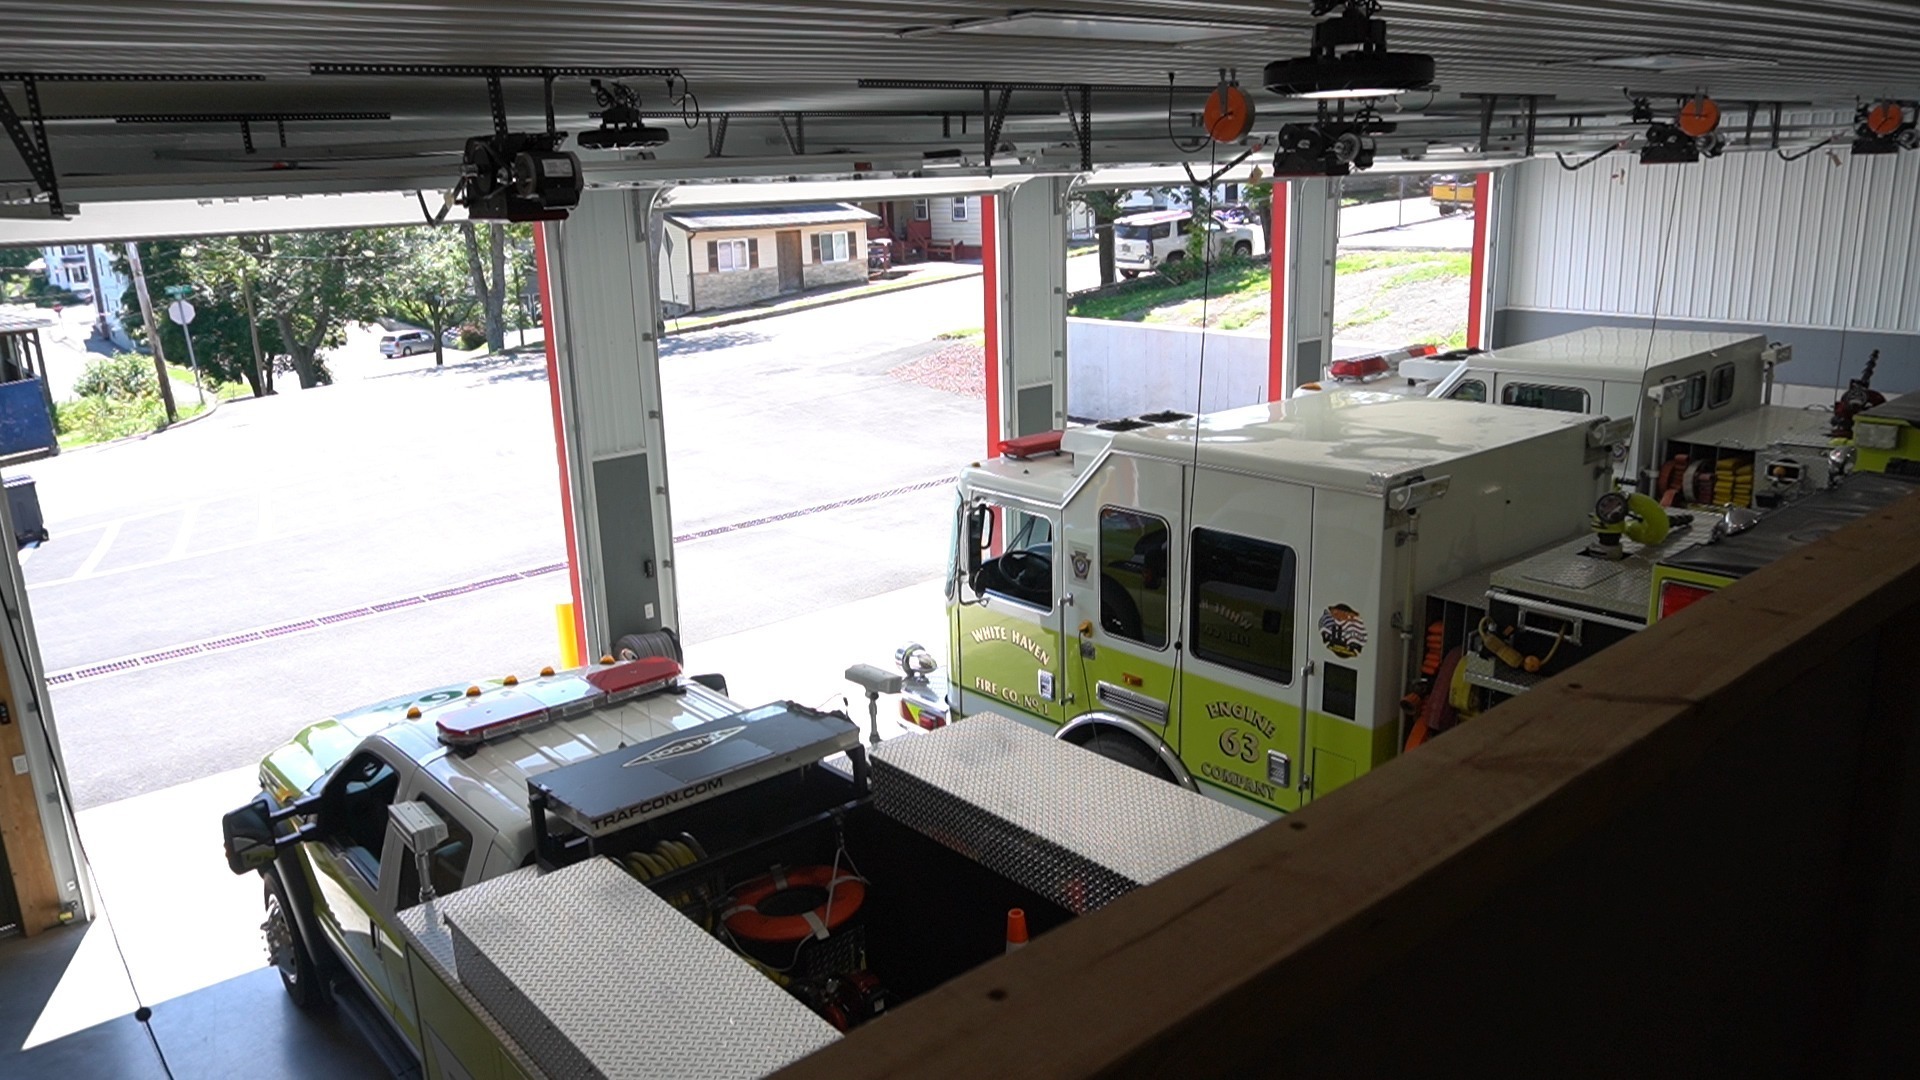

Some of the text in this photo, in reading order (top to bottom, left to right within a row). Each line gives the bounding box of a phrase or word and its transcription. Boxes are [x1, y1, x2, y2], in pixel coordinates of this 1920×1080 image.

[971, 625, 1050, 666] WHITE HAVEN
[975, 676, 998, 695] FIRE
[1206, 701, 1276, 739] ENGINE
[1219, 727, 1260, 764] 63
[1201, 762, 1276, 801] COMPANY
[591, 777, 724, 831] TRAFCON.COM
